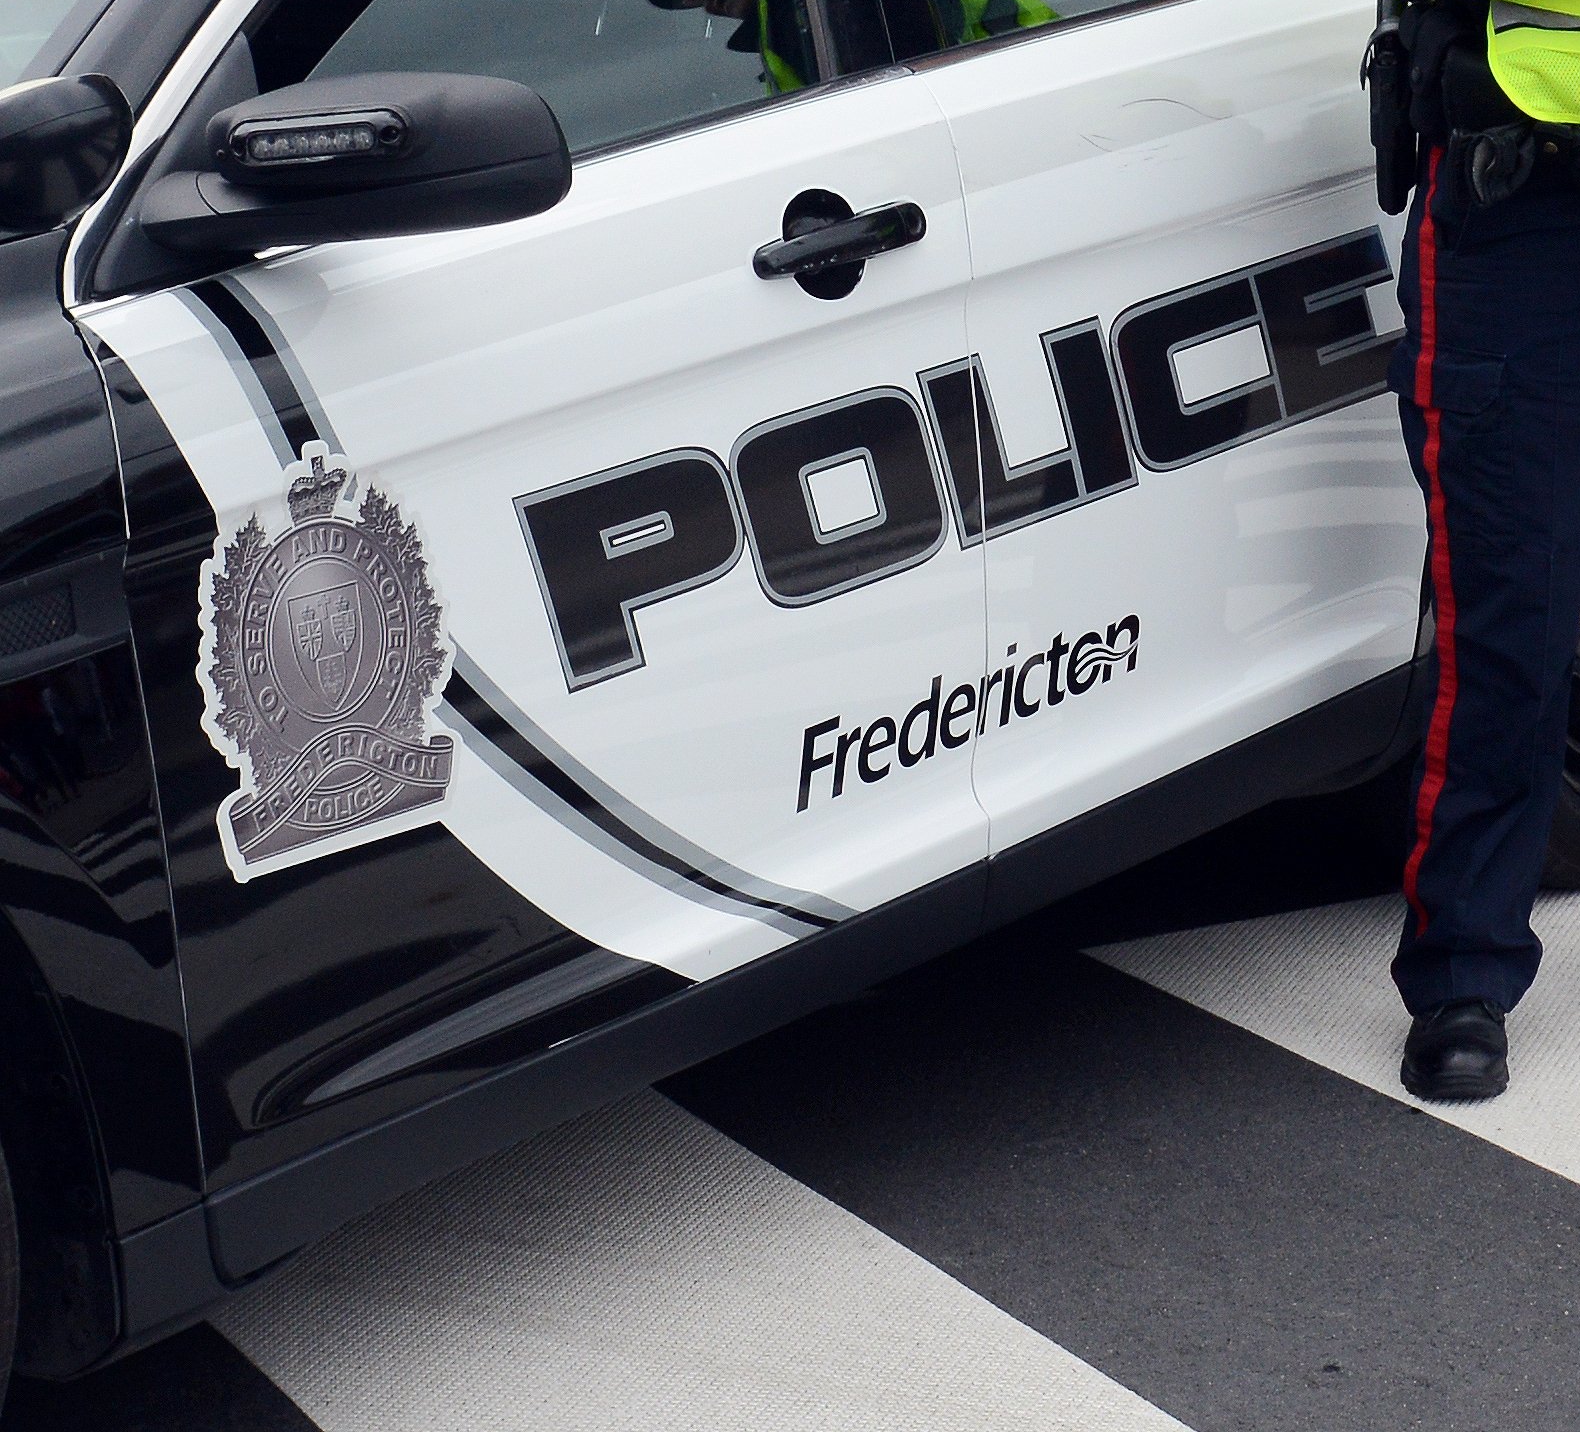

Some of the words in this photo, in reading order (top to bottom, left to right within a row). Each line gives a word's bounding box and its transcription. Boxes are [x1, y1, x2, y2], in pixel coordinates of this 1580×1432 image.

[512, 223, 1407, 694] POLICE
[292, 527, 347, 563] AND
[245, 554, 288, 676] SERVE
[353, 538, 408, 701] PROTECT
[258, 685, 289, 734] TO
[796, 614, 1141, 813] Fredericton
[252, 732, 438, 833] FREDERICTON
[303, 776, 384, 822] POLICE
